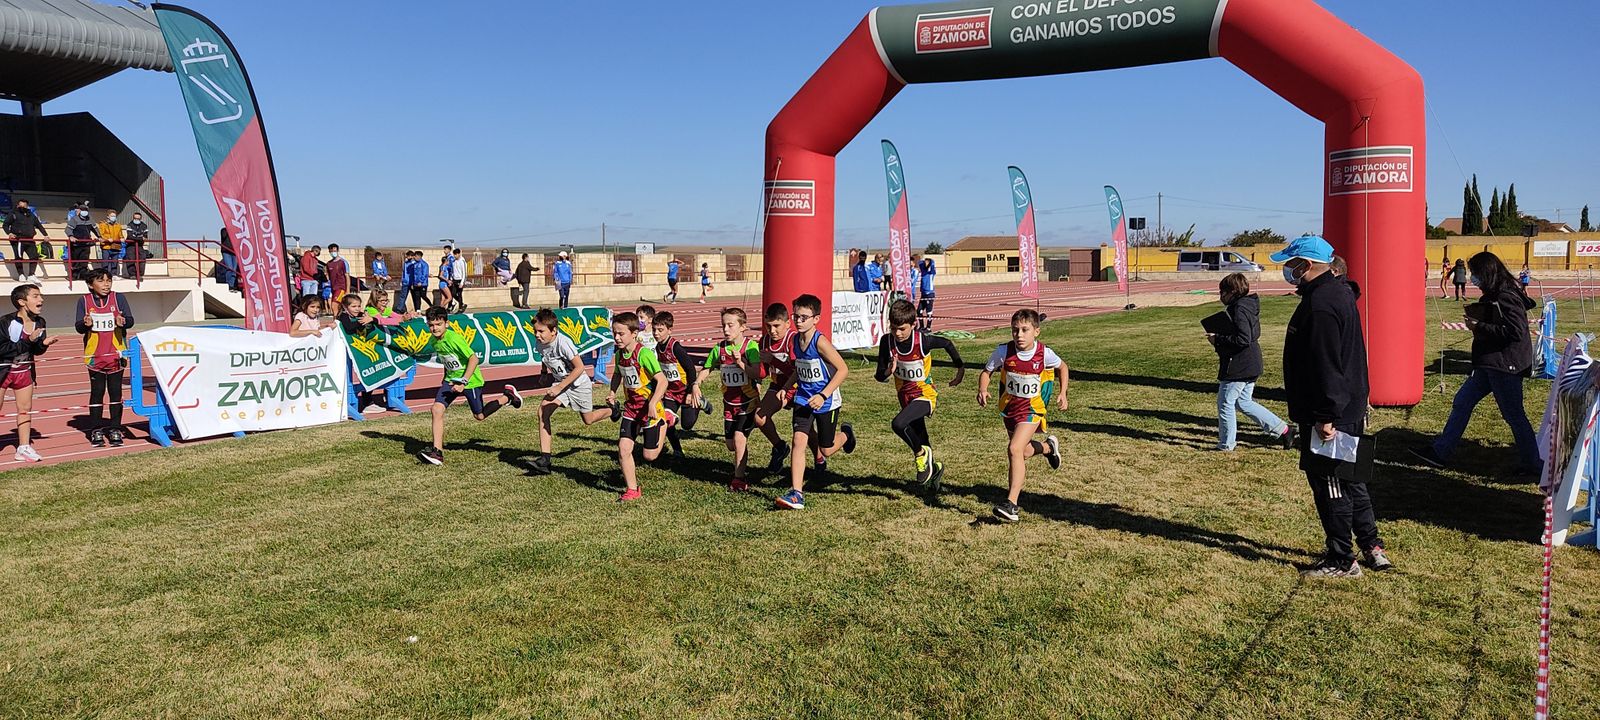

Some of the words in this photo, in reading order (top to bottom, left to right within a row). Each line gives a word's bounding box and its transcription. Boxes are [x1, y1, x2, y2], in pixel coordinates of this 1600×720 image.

[1010, 1, 1051, 20] CON
[1056, 0, 1079, 13] EL
[933, 22, 974, 33] DIPUTACIÓN
[975, 21, 986, 29] DE
[1009, 17, 1103, 44] GANAMOS
[1107, 5, 1176, 31] TODOS
[932, 29, 986, 44] ZAMORA
[1344, 162, 1394, 173] DIPUTACIÓN
[1344, 171, 1408, 185] ZAMORA
[986, 253, 1006, 261] BAR
[95, 320, 113, 329] 118
[833, 320, 865, 335] AMORA
[507, 348, 528, 356] RURAL
[896, 367, 923, 379] 4100
[217, 372, 341, 407] ZAMORA
[1007, 381, 1038, 395] 4103
[220, 399, 343, 421] deportes
